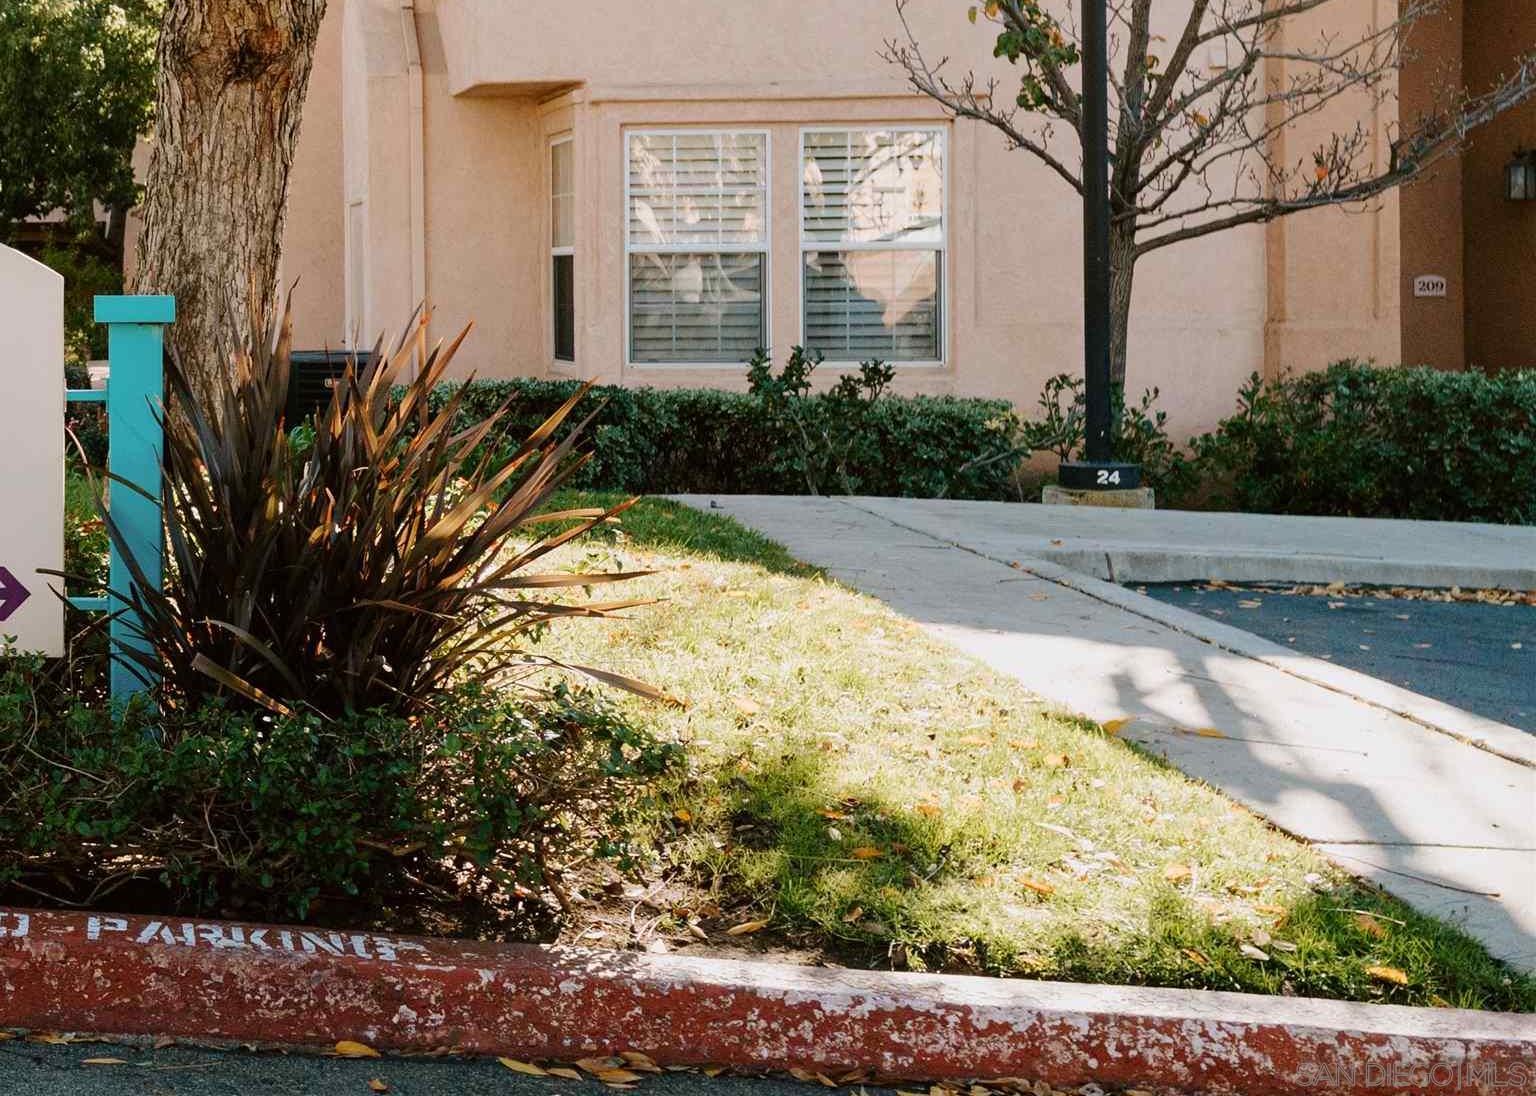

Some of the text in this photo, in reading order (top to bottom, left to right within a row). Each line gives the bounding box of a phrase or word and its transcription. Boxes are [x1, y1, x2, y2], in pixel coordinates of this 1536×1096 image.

[1418, 280, 1444, 291] 209
[1096, 470, 1121, 485] 24
[87, 915, 398, 961] PARKING
